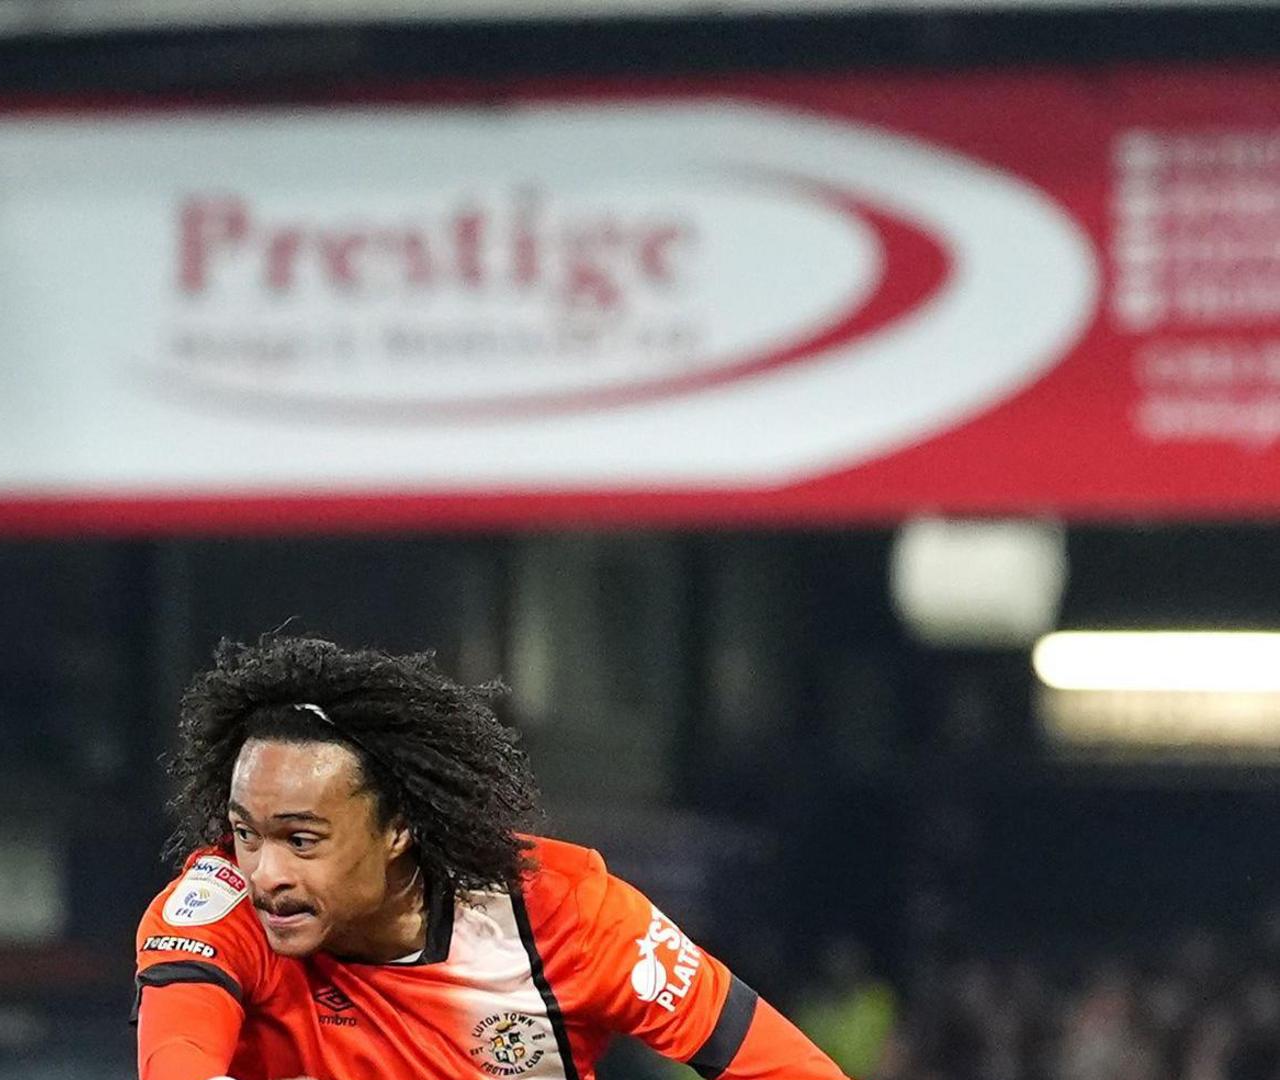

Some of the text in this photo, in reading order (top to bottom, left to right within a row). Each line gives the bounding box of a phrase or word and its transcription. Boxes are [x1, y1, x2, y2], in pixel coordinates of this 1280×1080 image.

[174, 182, 698, 312] Prestige
[175, 907, 194, 918] EFL
[143, 936, 215, 958] TOGETHER
[472, 1012, 536, 1038] LUTON TOWN
[480, 1049, 545, 1076] FOOTBALL CLUB
